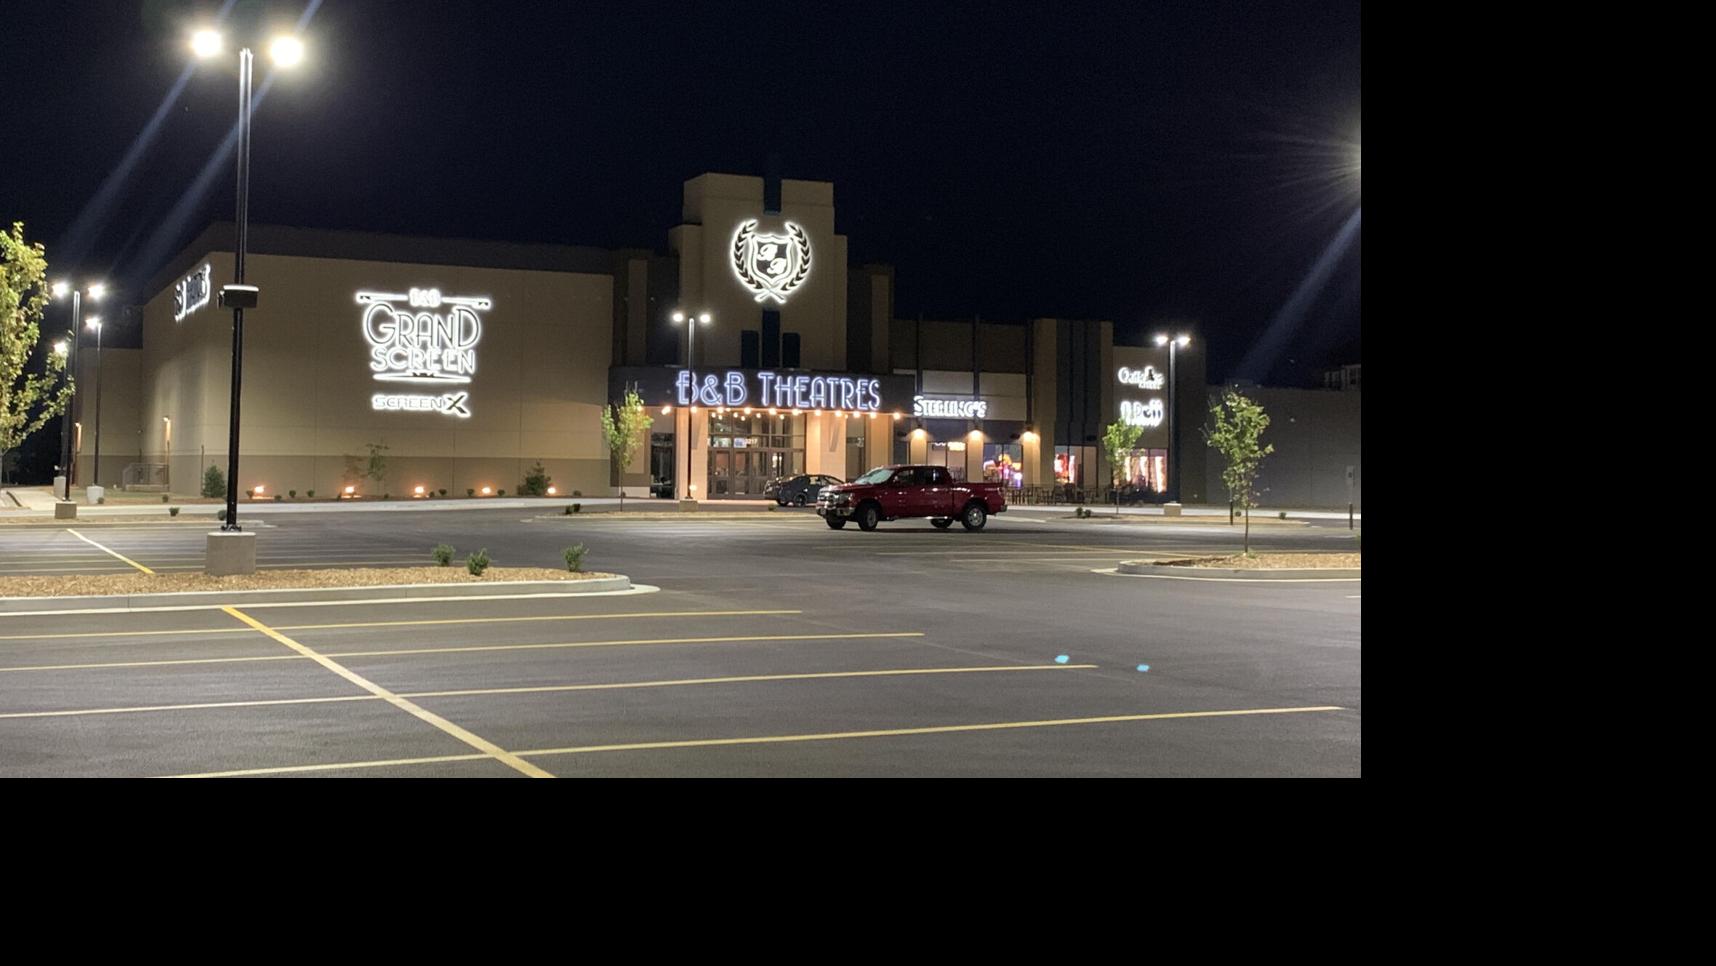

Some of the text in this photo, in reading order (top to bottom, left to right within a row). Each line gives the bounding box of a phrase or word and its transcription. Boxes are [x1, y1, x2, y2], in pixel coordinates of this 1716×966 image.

[363, 301, 482, 349] GRAND
[370, 346, 475, 374] SCREEN
[675, 370, 882, 411] B&B THEATRES
